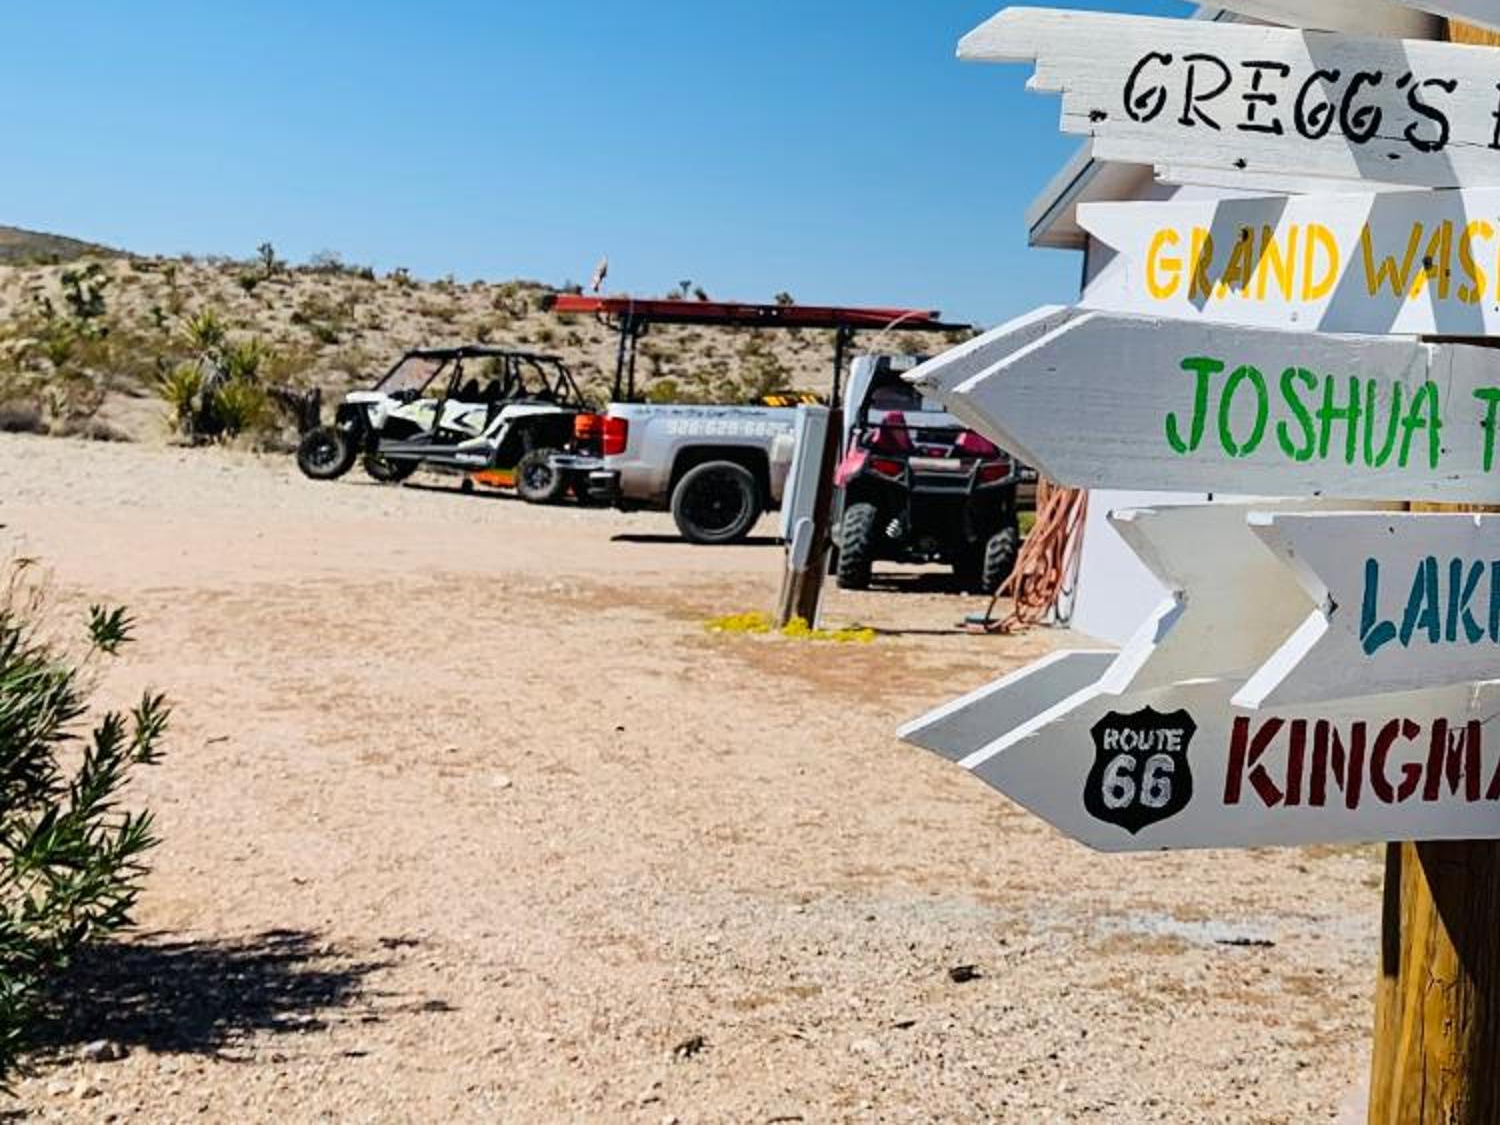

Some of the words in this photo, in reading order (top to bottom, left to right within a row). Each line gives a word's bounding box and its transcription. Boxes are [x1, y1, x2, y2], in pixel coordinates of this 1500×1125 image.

[1123, 52, 1457, 152] GREGG'S
[1145, 221, 1342, 303] GRAND
[1165, 356, 1442, 469] JOSHUA
[1103, 727, 1184, 751] ROUTE
[1102, 753, 1175, 810] 66
